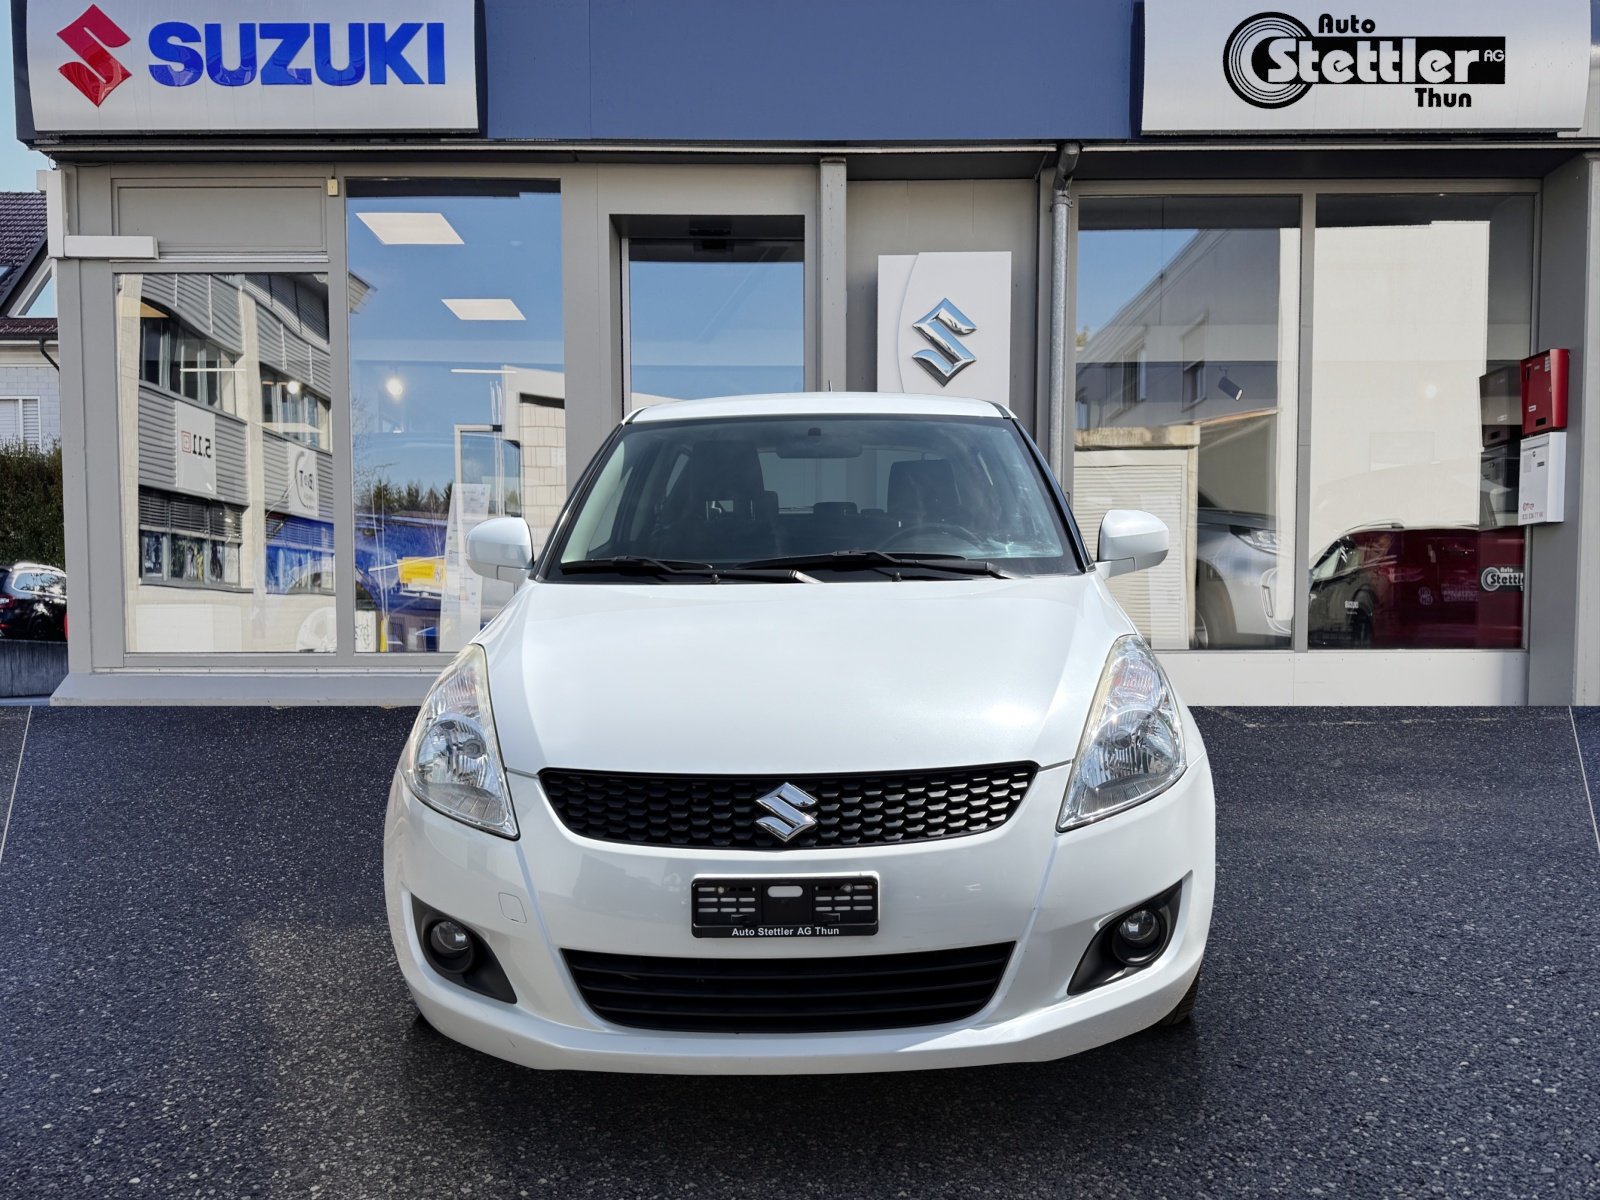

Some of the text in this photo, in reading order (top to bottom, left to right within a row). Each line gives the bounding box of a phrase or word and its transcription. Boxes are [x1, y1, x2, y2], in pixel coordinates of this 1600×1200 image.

[1318, 13, 1376, 34] Auto
[148, 21, 445, 87] SUZUKI
[1267, 37, 1505, 84] Stettler AG
[1414, 87, 1472, 108] Thun
[731, 926, 840, 936] Auto Stettler AG Thun
